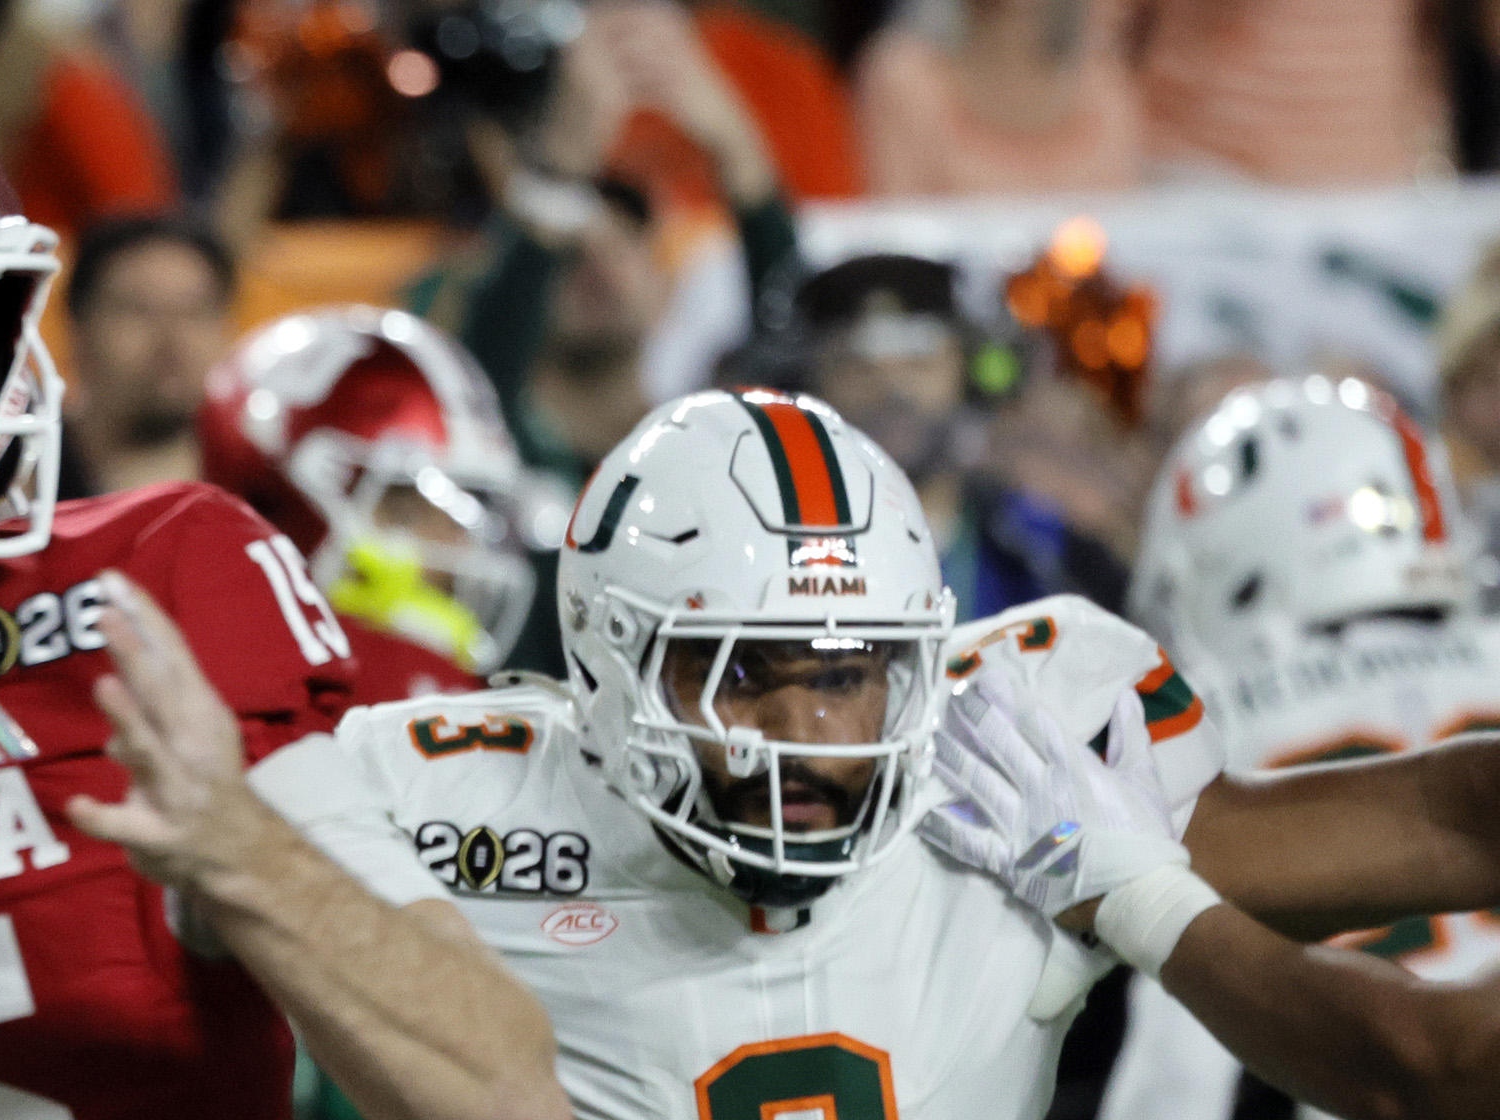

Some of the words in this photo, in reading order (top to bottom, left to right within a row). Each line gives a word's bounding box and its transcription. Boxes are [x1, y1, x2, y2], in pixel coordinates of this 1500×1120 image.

[245, 534, 351, 665] 15
[788, 576, 867, 596] MIAMI
[415, 821, 590, 897] 2026
[554, 912, 605, 931] ACC
